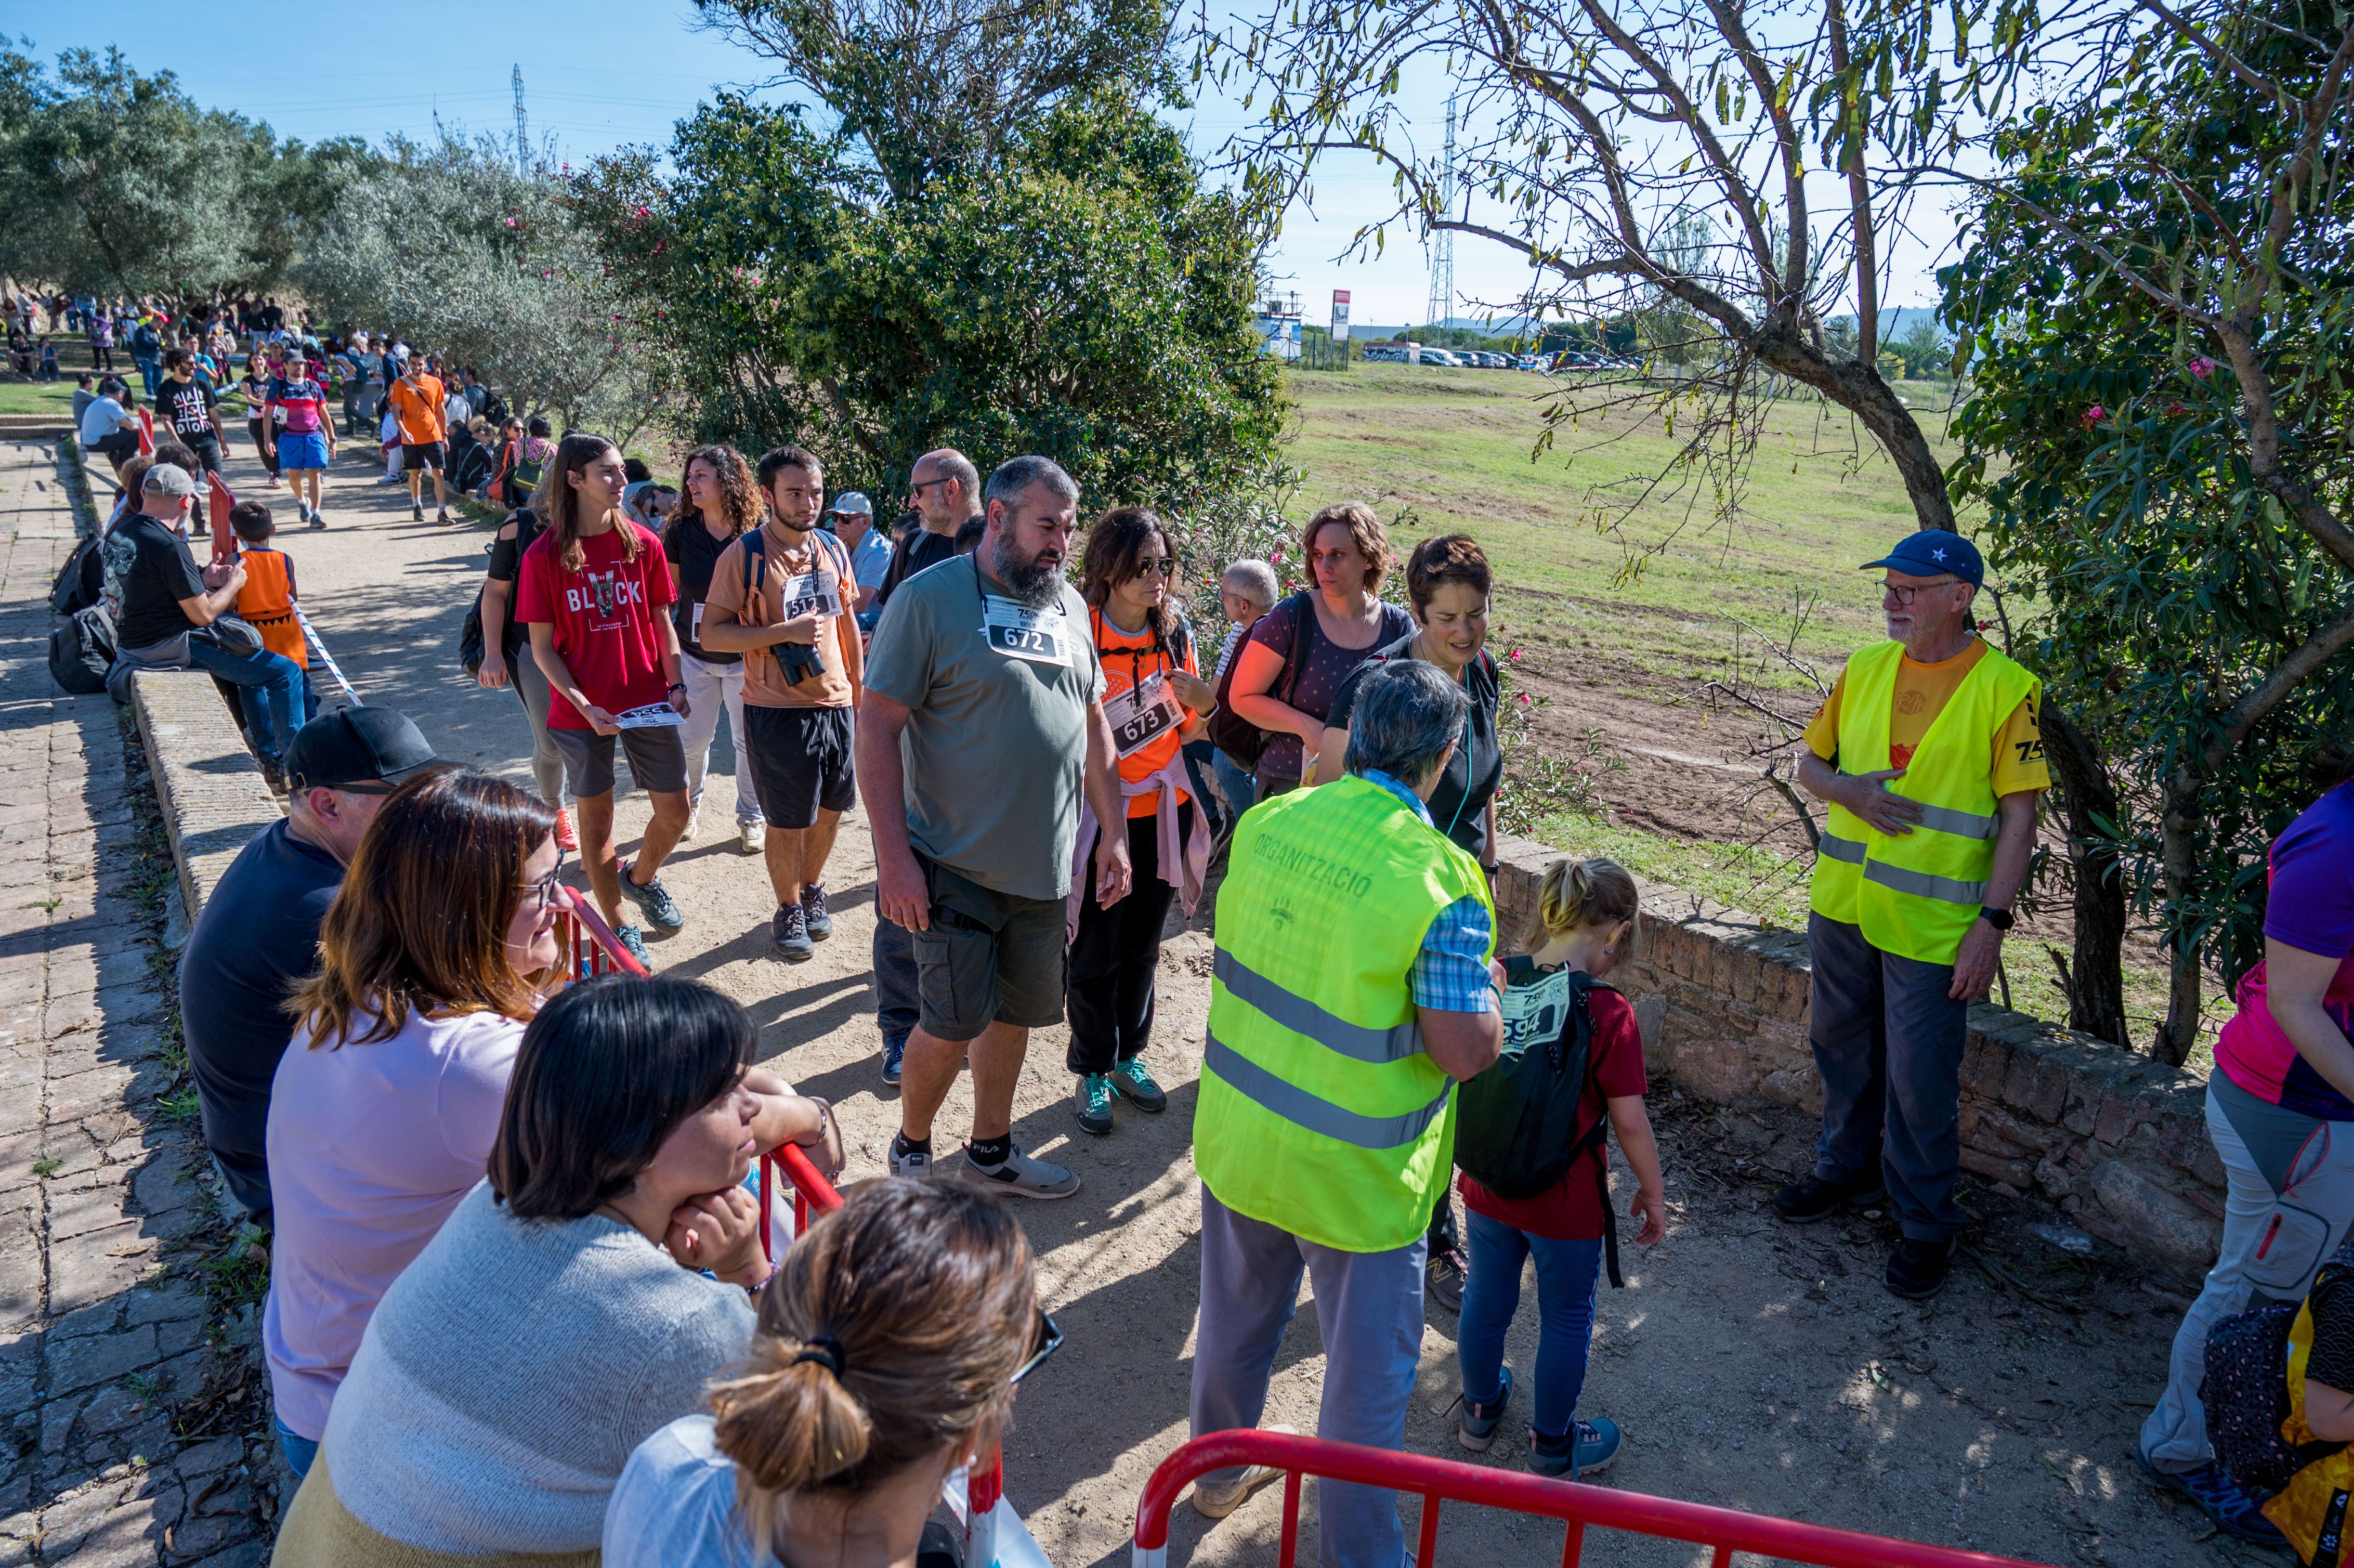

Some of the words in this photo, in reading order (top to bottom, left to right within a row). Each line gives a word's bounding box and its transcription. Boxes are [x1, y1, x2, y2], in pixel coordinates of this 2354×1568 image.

[791, 597, 820, 615] 512
[1004, 628, 1044, 651] 672
[631, 707, 664, 717] 554
[1124, 710, 1159, 741] 673
[2015, 740, 2045, 762] 75
[1253, 833, 1374, 898] ORGANITZACIÓ
[973, 1143, 1000, 1153] FILA
